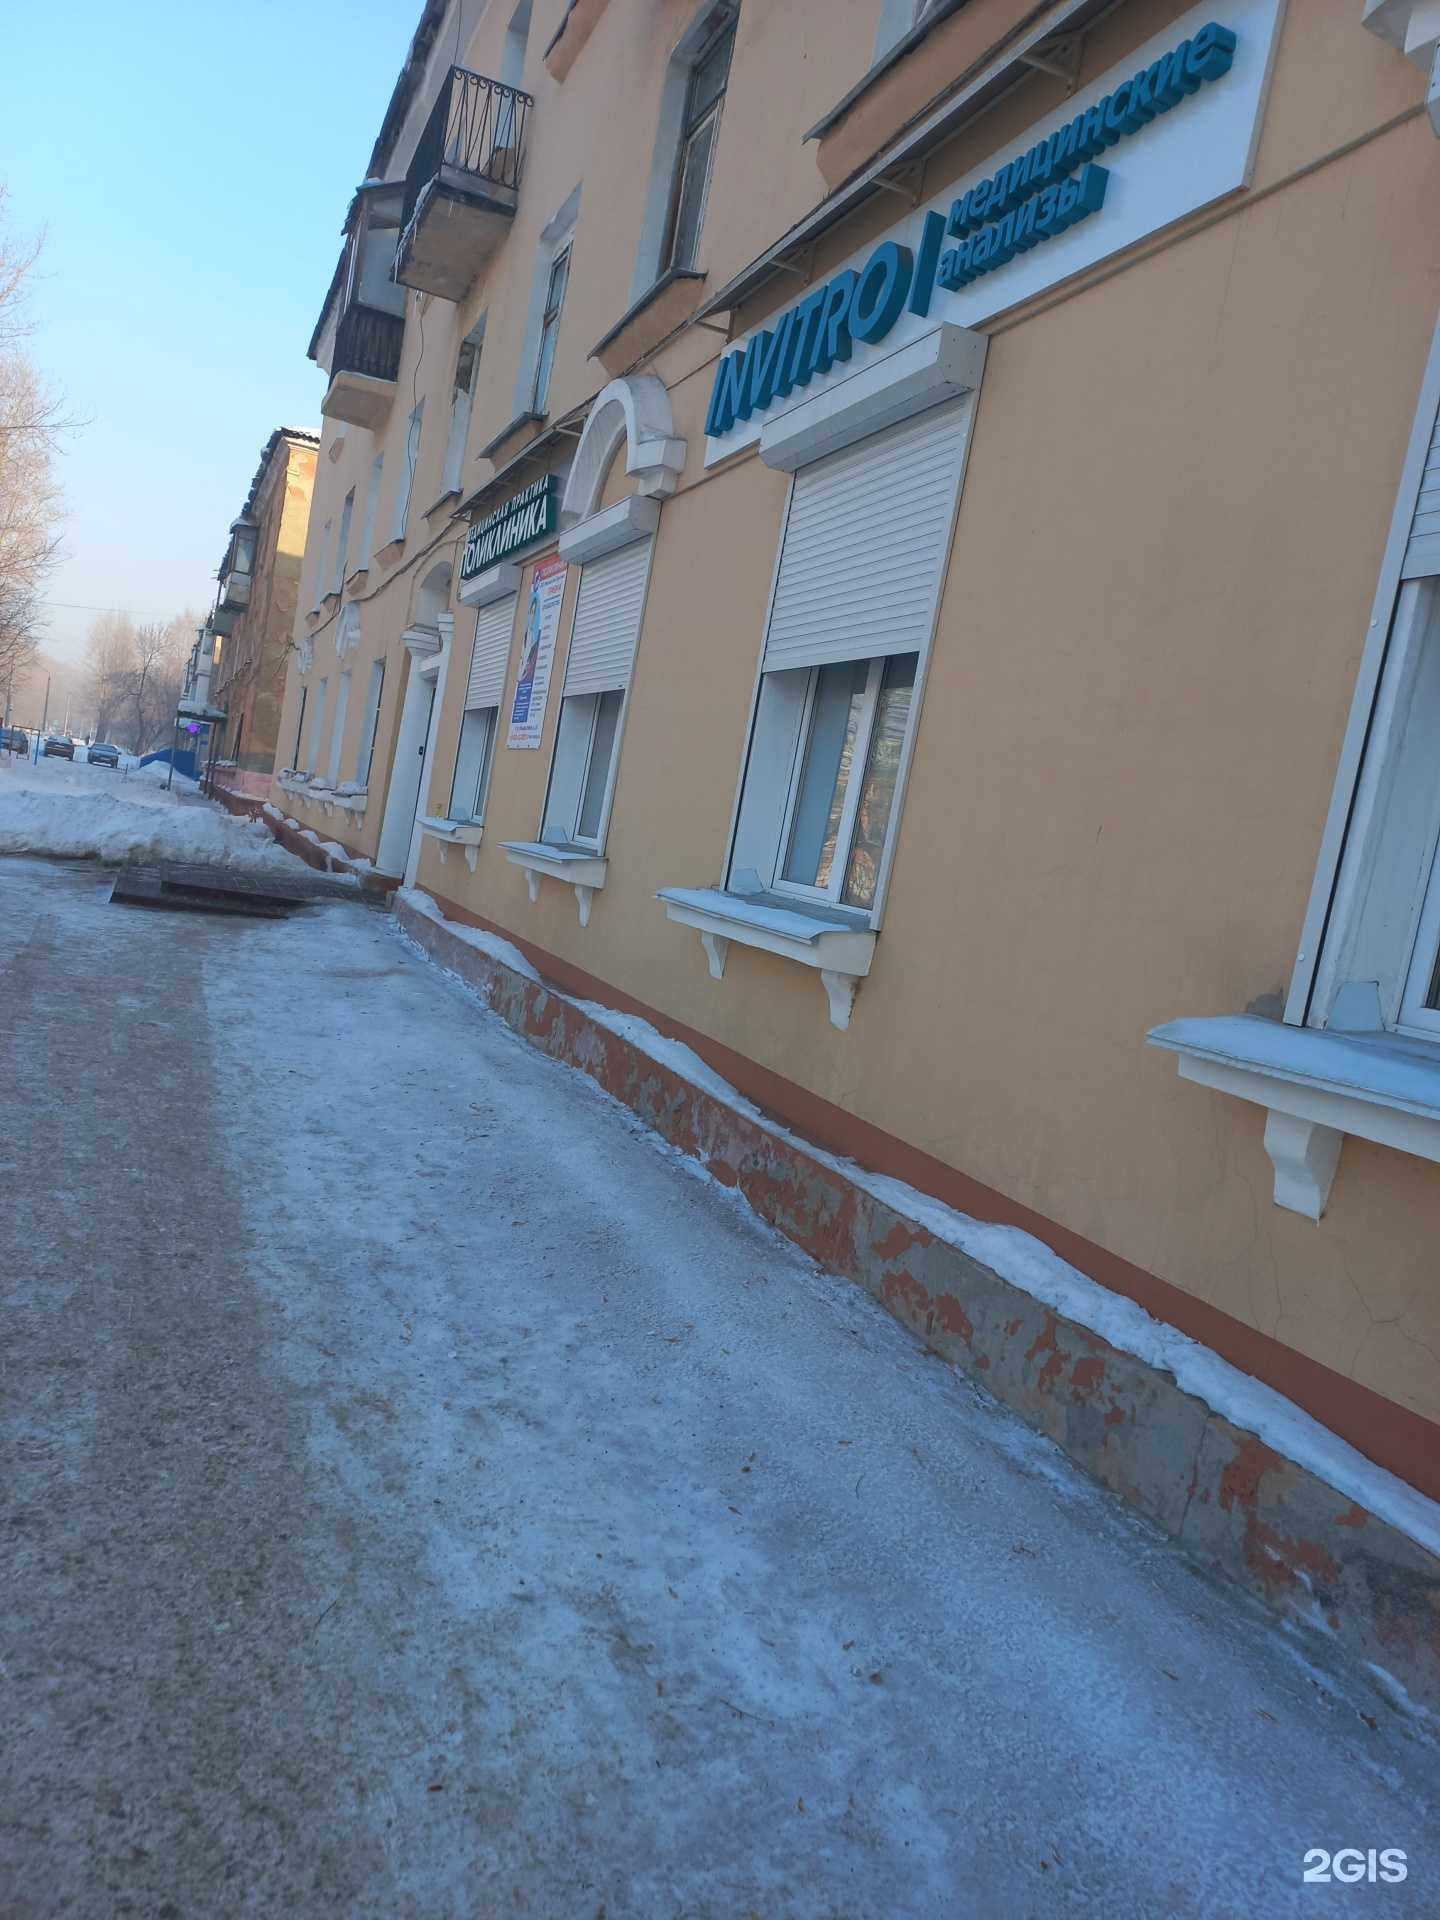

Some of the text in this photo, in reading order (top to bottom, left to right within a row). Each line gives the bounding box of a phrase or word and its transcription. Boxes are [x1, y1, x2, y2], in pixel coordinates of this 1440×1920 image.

[947, 21, 1237, 240] медицинские
[936, 162, 1110, 292] анализы
[704, 240, 914, 437] INVITRO
[460, 494, 548, 577] ПОЛИКЛИНИКА
